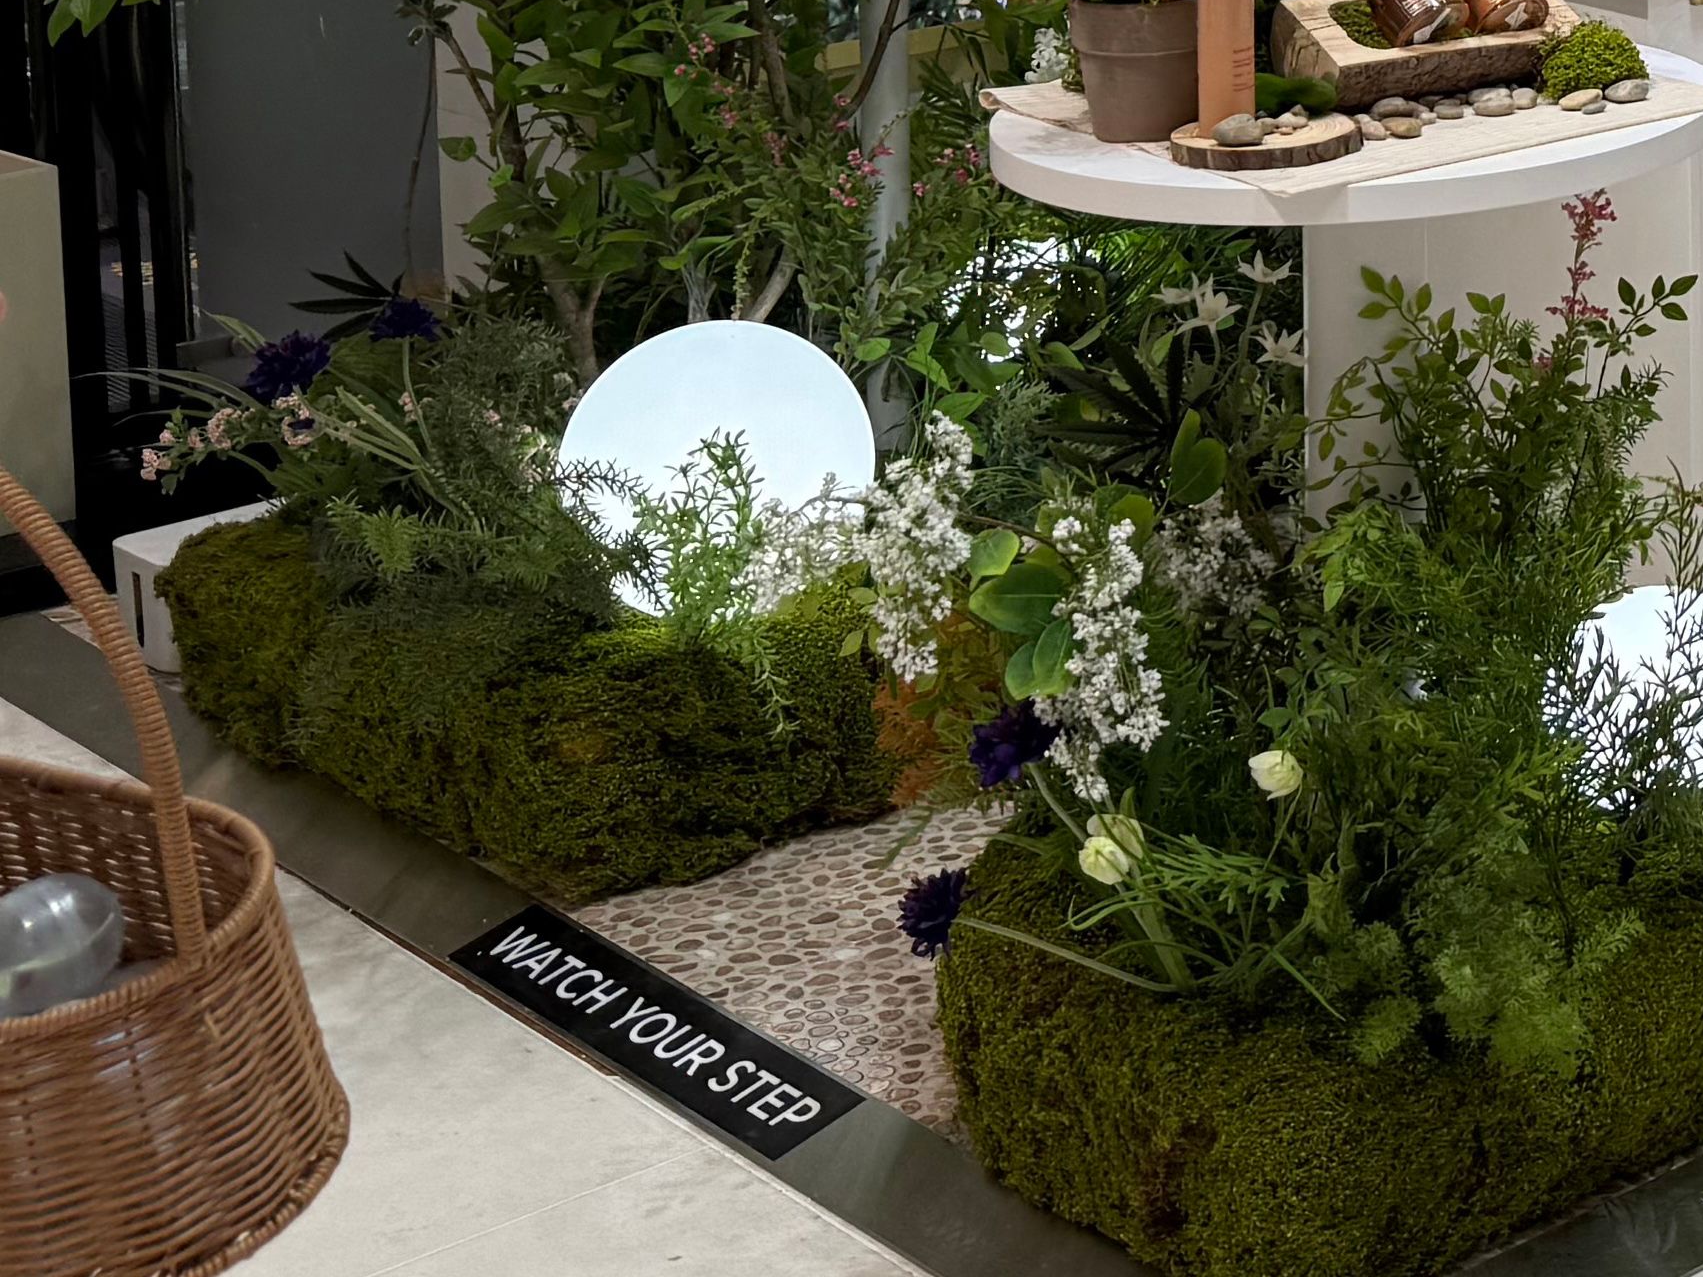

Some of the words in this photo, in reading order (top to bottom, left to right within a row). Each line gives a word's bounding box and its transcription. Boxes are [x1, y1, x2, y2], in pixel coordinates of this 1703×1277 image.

[488, 924, 629, 1016] WATCH
[607, 996, 726, 1078] YOUR
[706, 1059, 822, 1131] STEP
